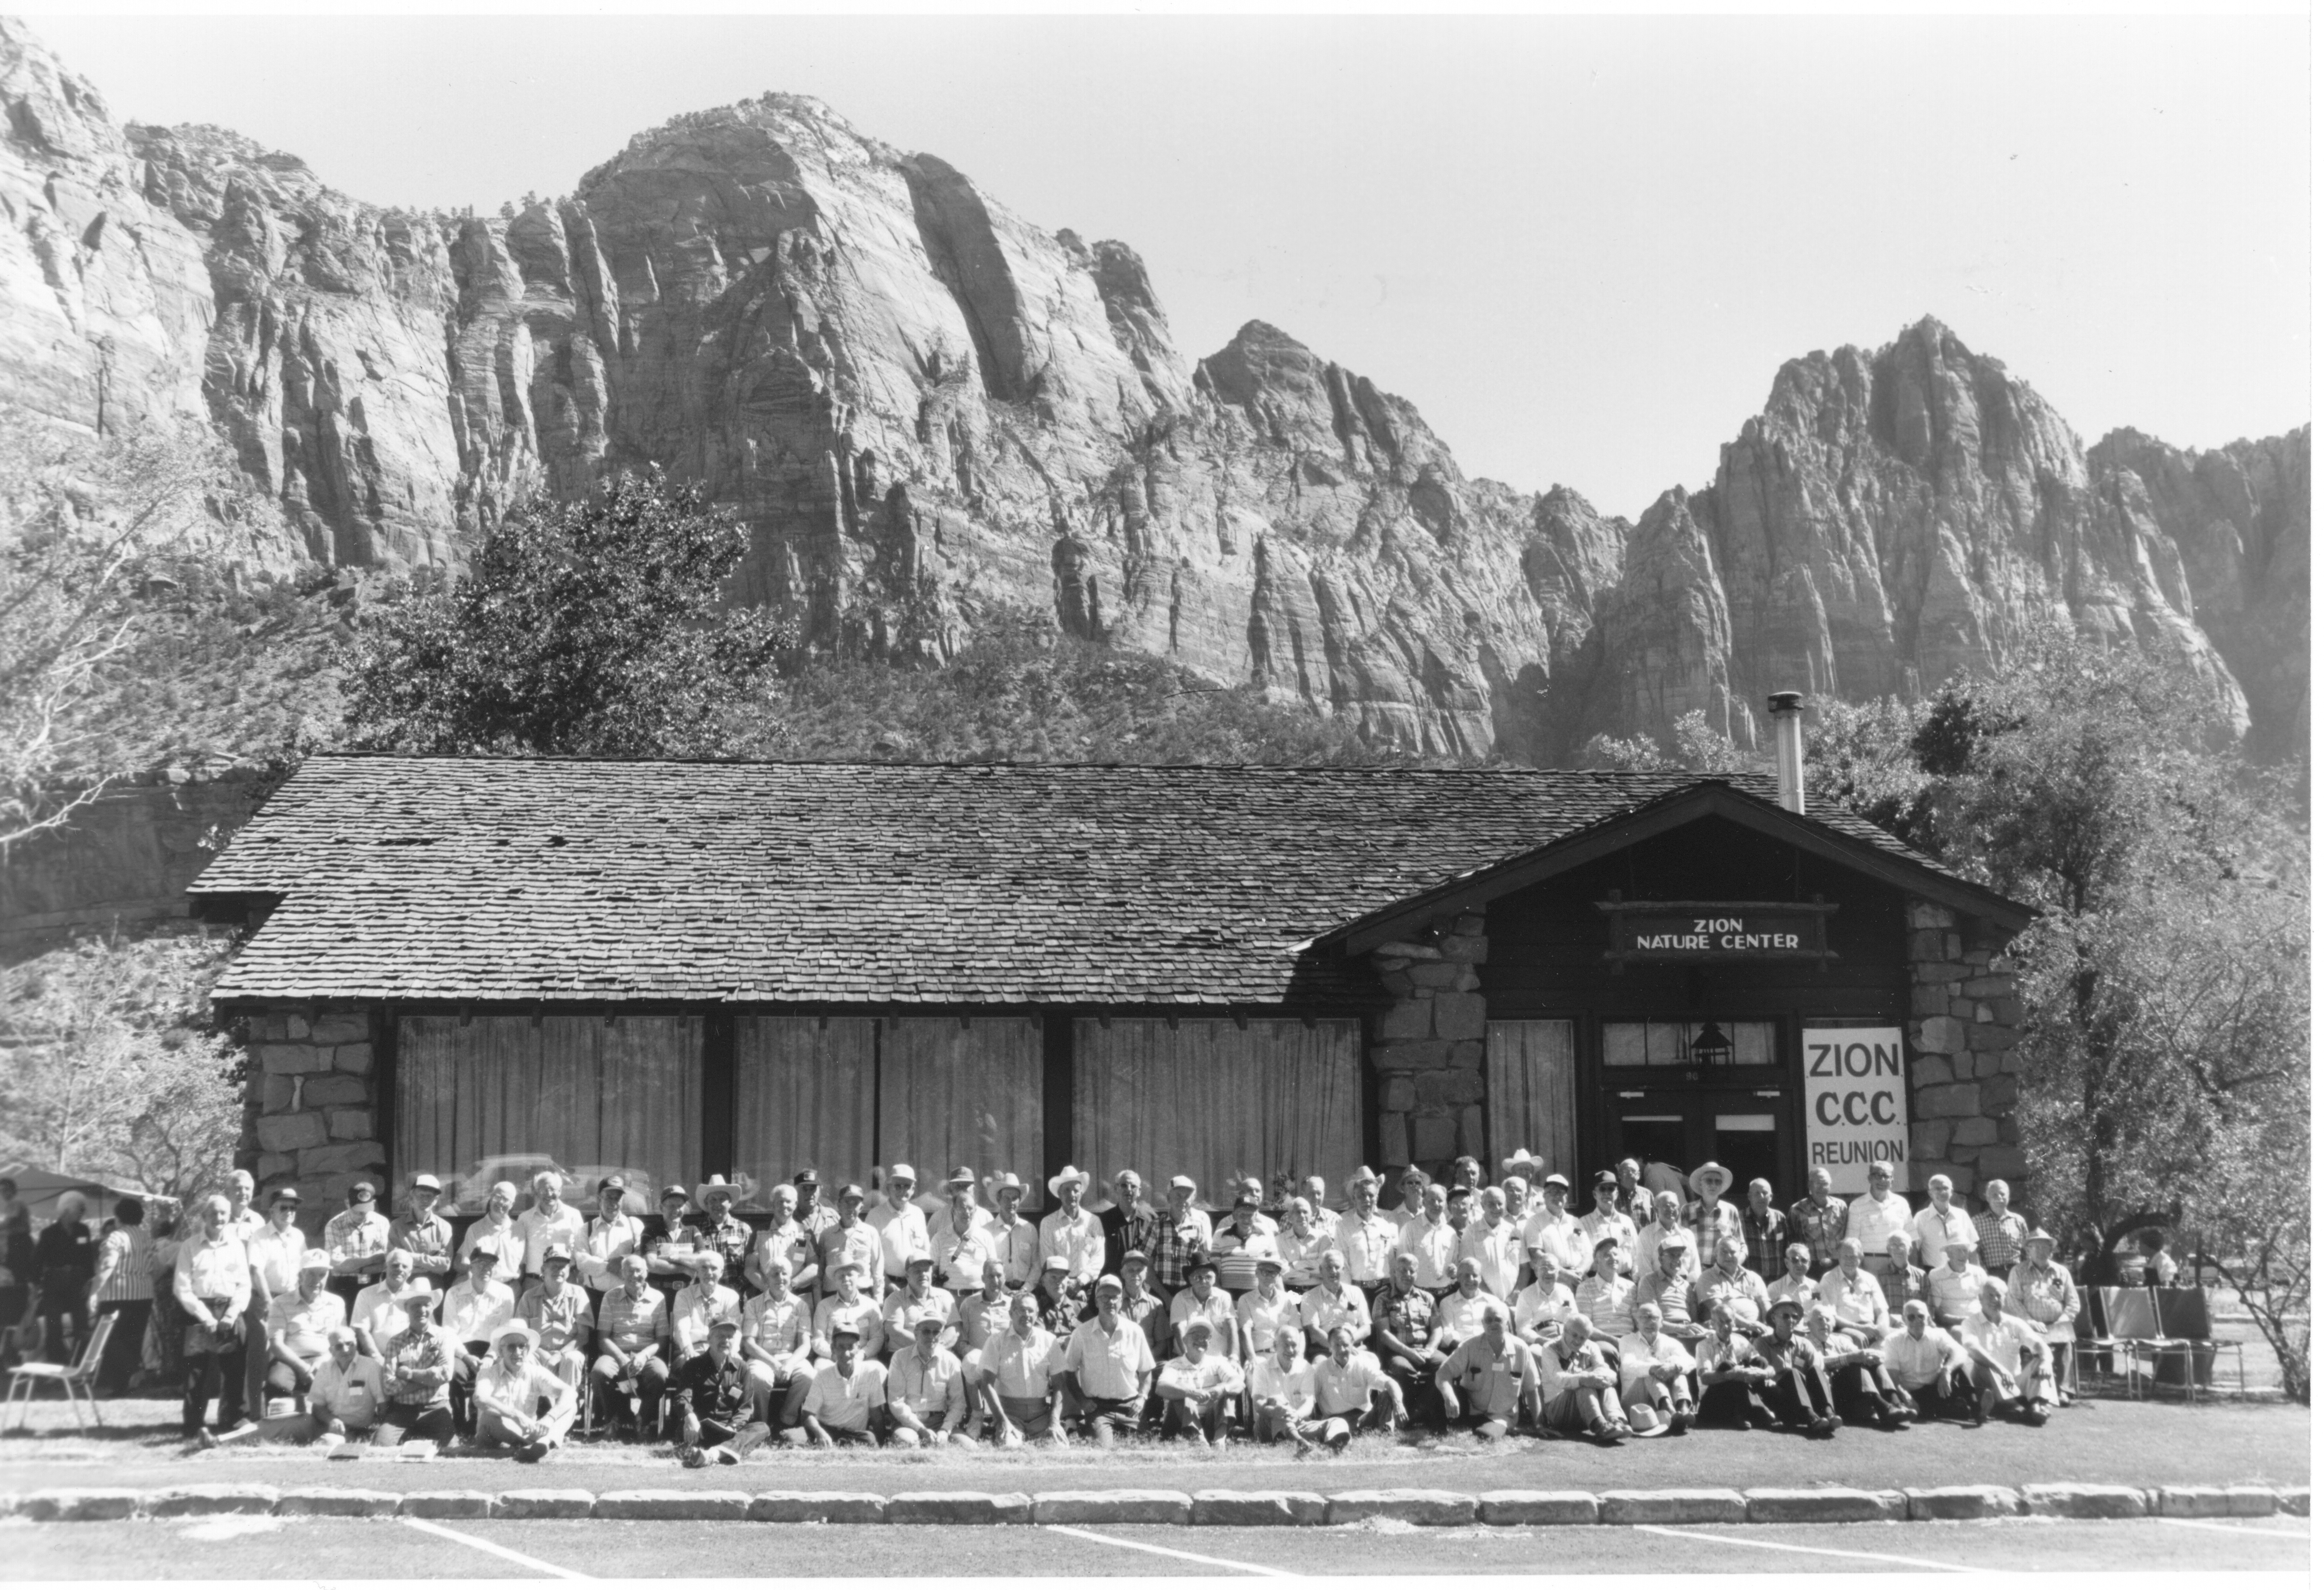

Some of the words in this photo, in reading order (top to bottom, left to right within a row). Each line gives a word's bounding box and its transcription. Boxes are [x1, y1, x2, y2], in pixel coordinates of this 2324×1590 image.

[1694, 918, 1743, 933] ZION
[1637, 935, 1710, 949] NATURE
[1721, 933, 1798, 949] CENTER
[1808, 1043, 1899, 1077] ZION
[1815, 1090, 1900, 1126] C.C.C.
[1812, 1140, 1904, 1164] REUNION
